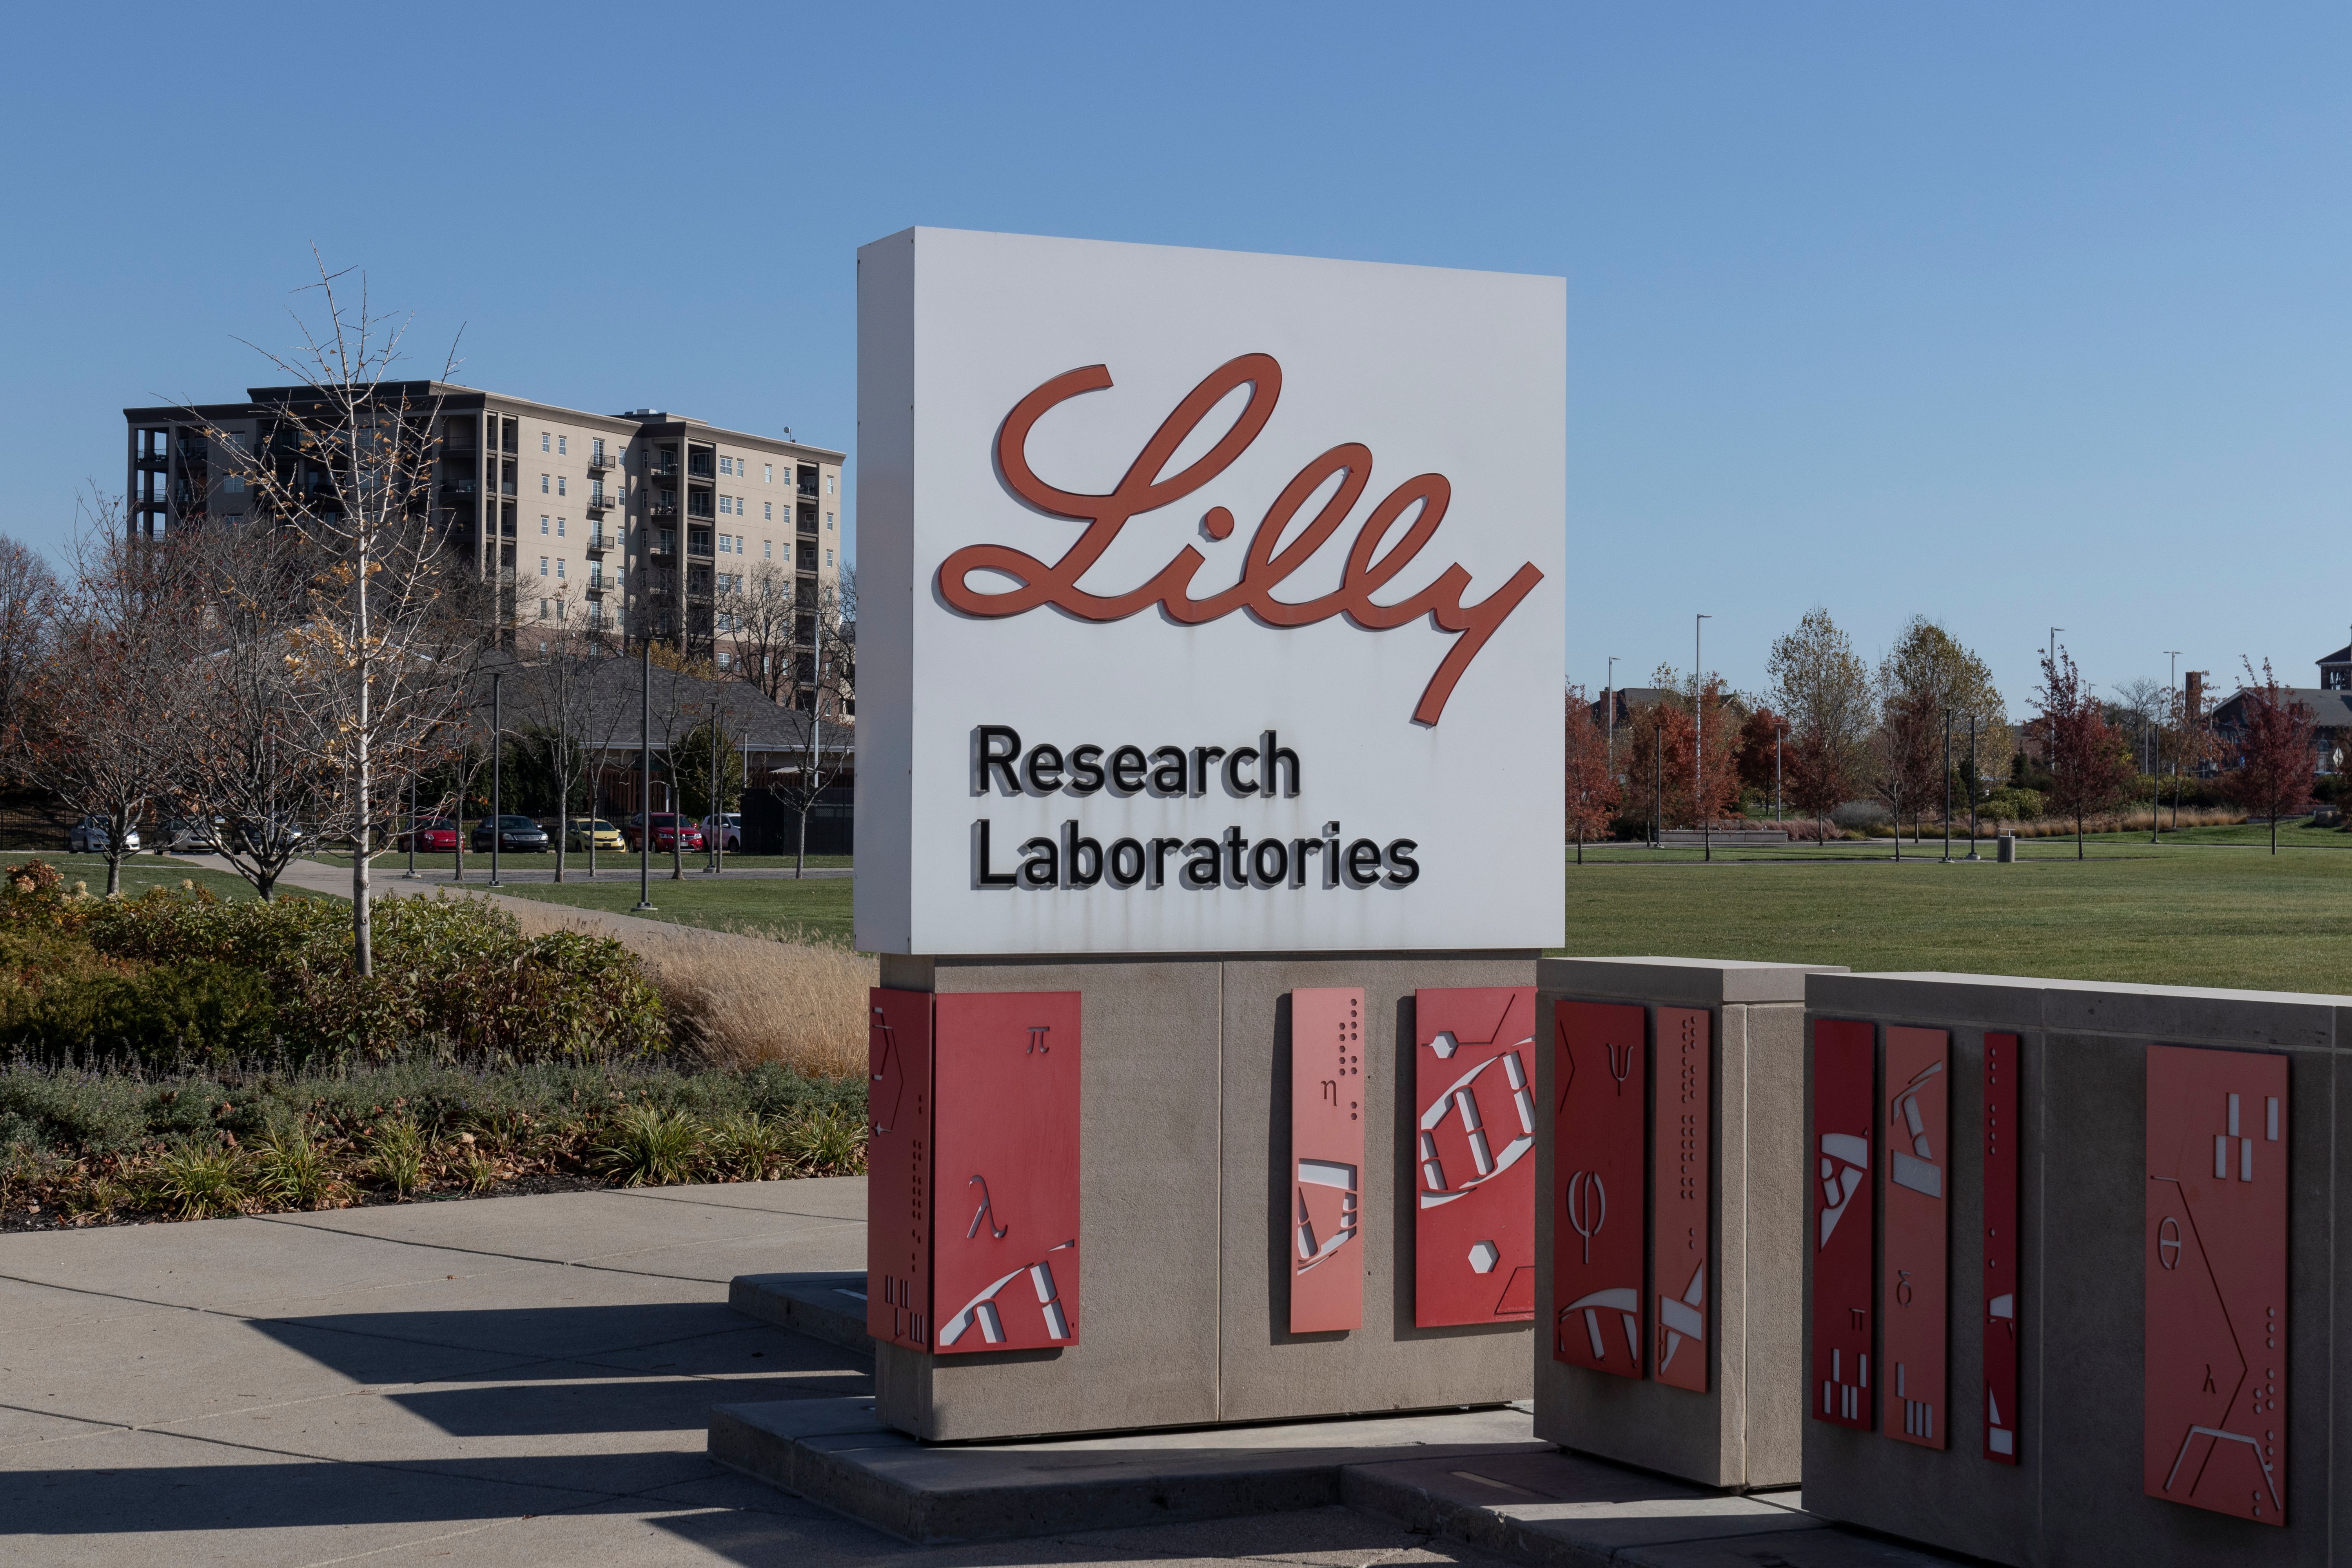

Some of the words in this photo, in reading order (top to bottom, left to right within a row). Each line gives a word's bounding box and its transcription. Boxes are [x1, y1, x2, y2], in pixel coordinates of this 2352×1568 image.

[938, 353, 1544, 726] Lilly
[976, 725, 1300, 796] Research
[976, 819, 1420, 887] Laboratories
